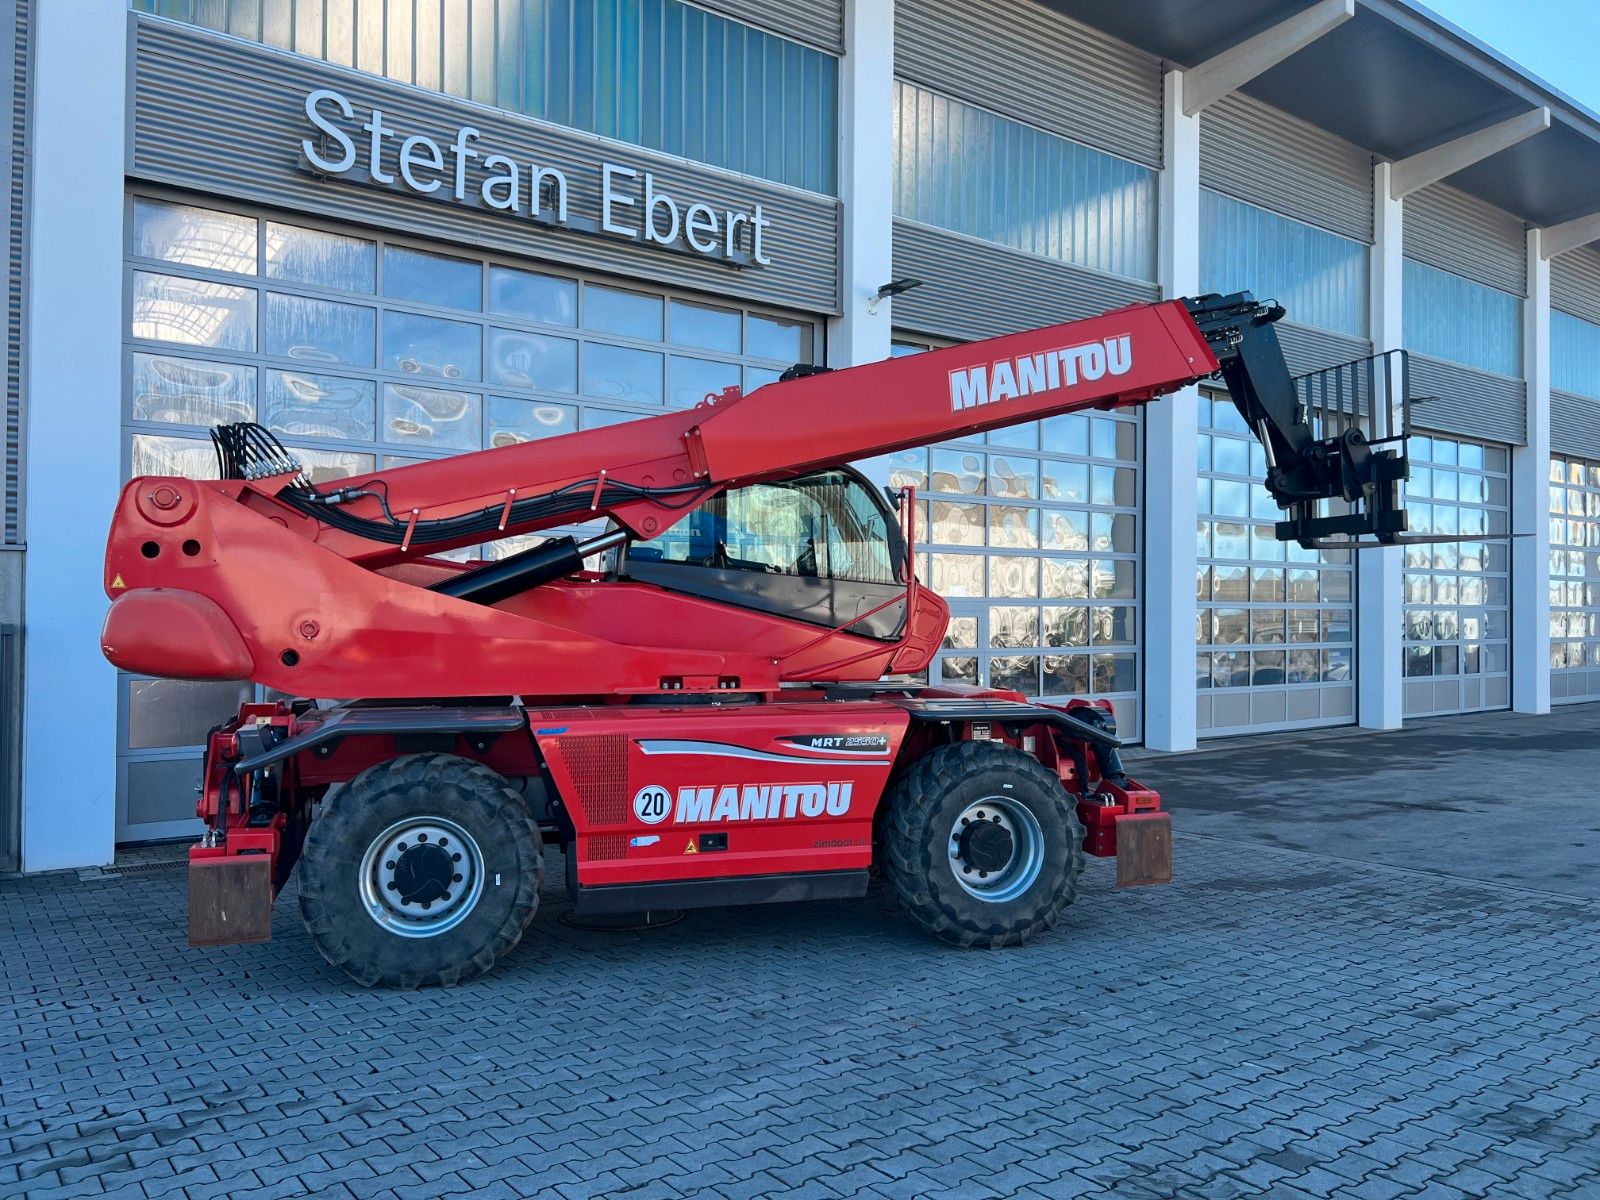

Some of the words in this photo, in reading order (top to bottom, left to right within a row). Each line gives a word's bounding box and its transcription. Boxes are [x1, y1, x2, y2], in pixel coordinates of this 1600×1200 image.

[301, 88, 569, 223] Stefan
[601, 161, 772, 266] Ebert
[949, 333, 1133, 412] MANITOU
[810, 737, 844, 748] MRT
[641, 792, 664, 817] 20
[674, 781, 854, 823] MANITOU
